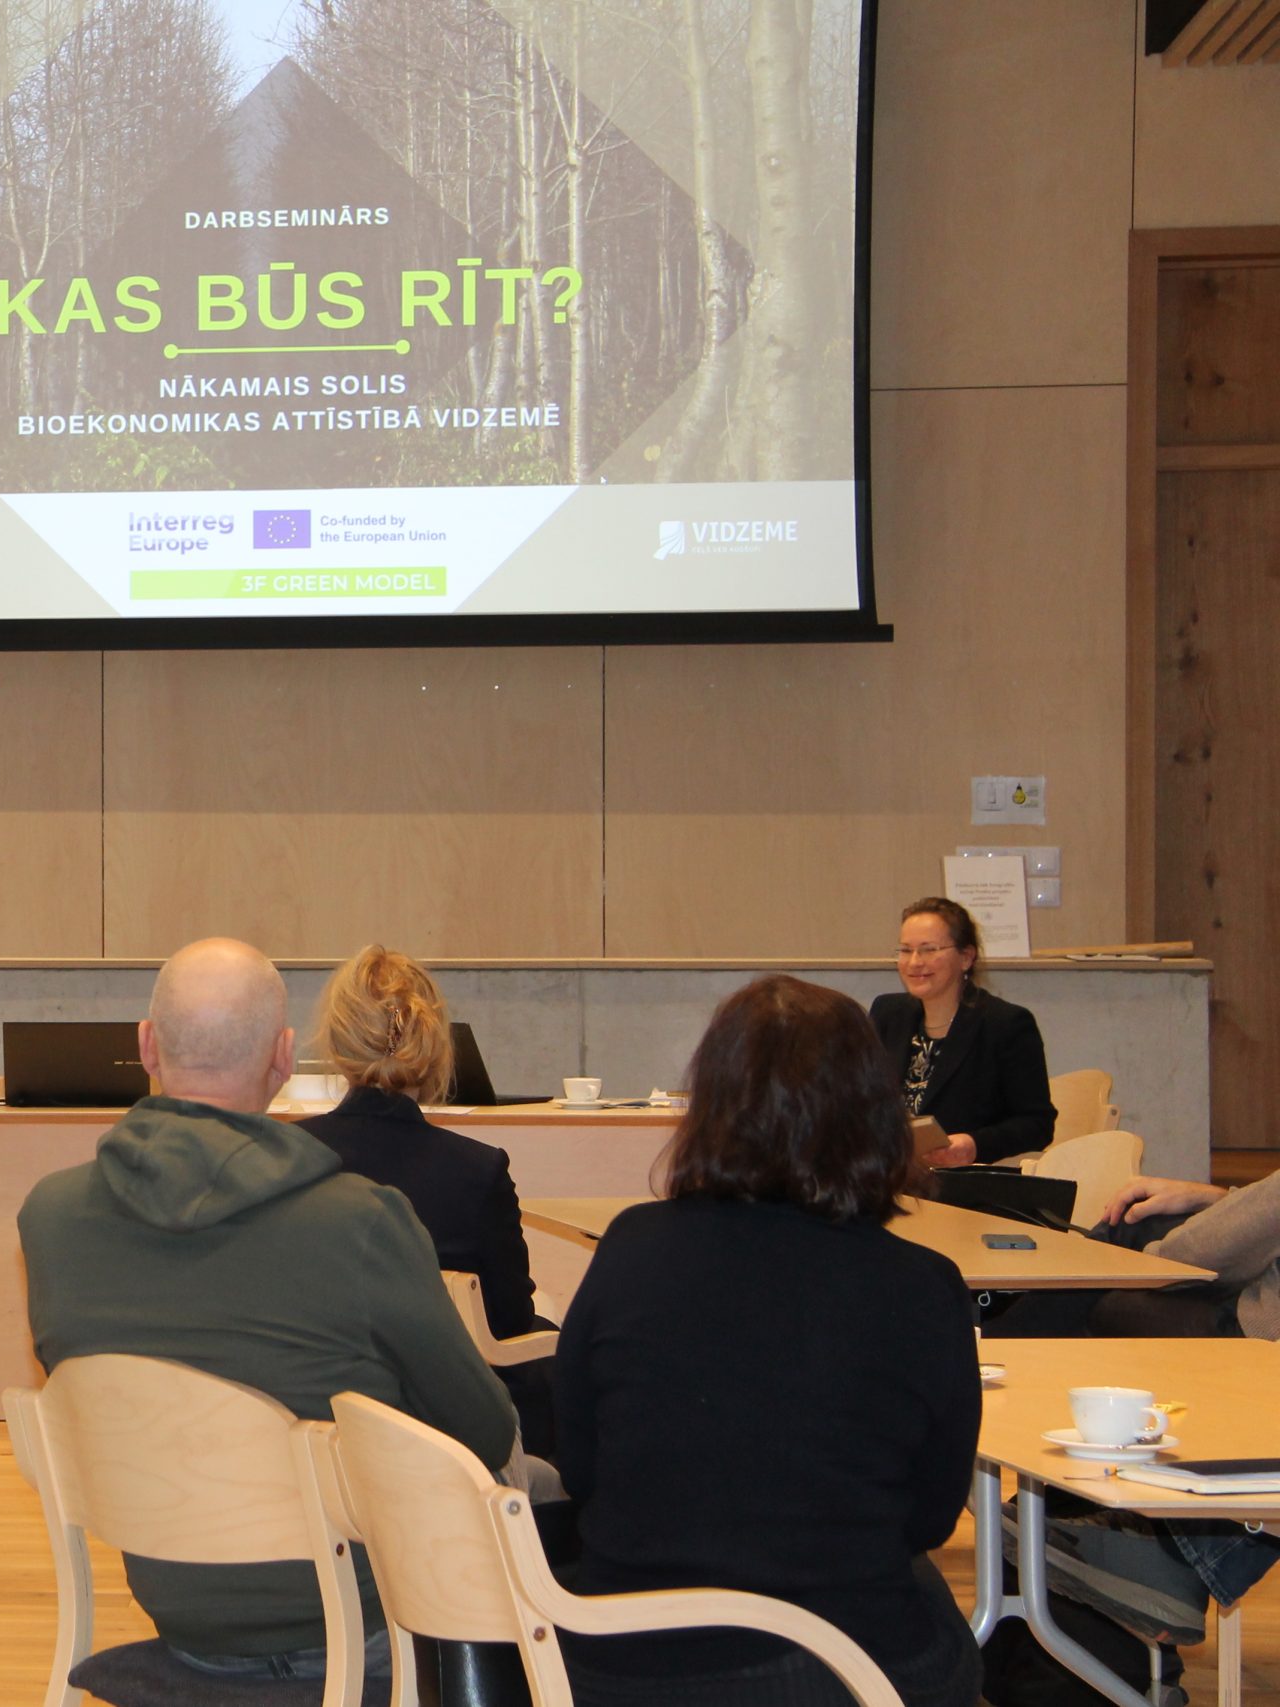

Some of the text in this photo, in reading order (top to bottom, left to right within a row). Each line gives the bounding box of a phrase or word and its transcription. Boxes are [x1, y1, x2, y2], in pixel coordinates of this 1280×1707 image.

[184, 207, 390, 230] DARBSEMINĀRS
[197, 262, 366, 331] BŪS
[401, 257, 584, 328] RĪT?
[159, 374, 406, 399] NĀKAMAIS SOLIS
[18, 402, 561, 436] BIOEKONOMIKAS ATTĪSTĪBĀ VIDZEMĒ
[128, 511, 235, 534] Interreg
[320, 515, 406, 528] Co-funded by
[691, 520, 799, 543] VIDZEME
[128, 534, 209, 555] Europe
[320, 529, 447, 544] the European Union
[241, 573, 436, 592] 3F GREEN MODEL
